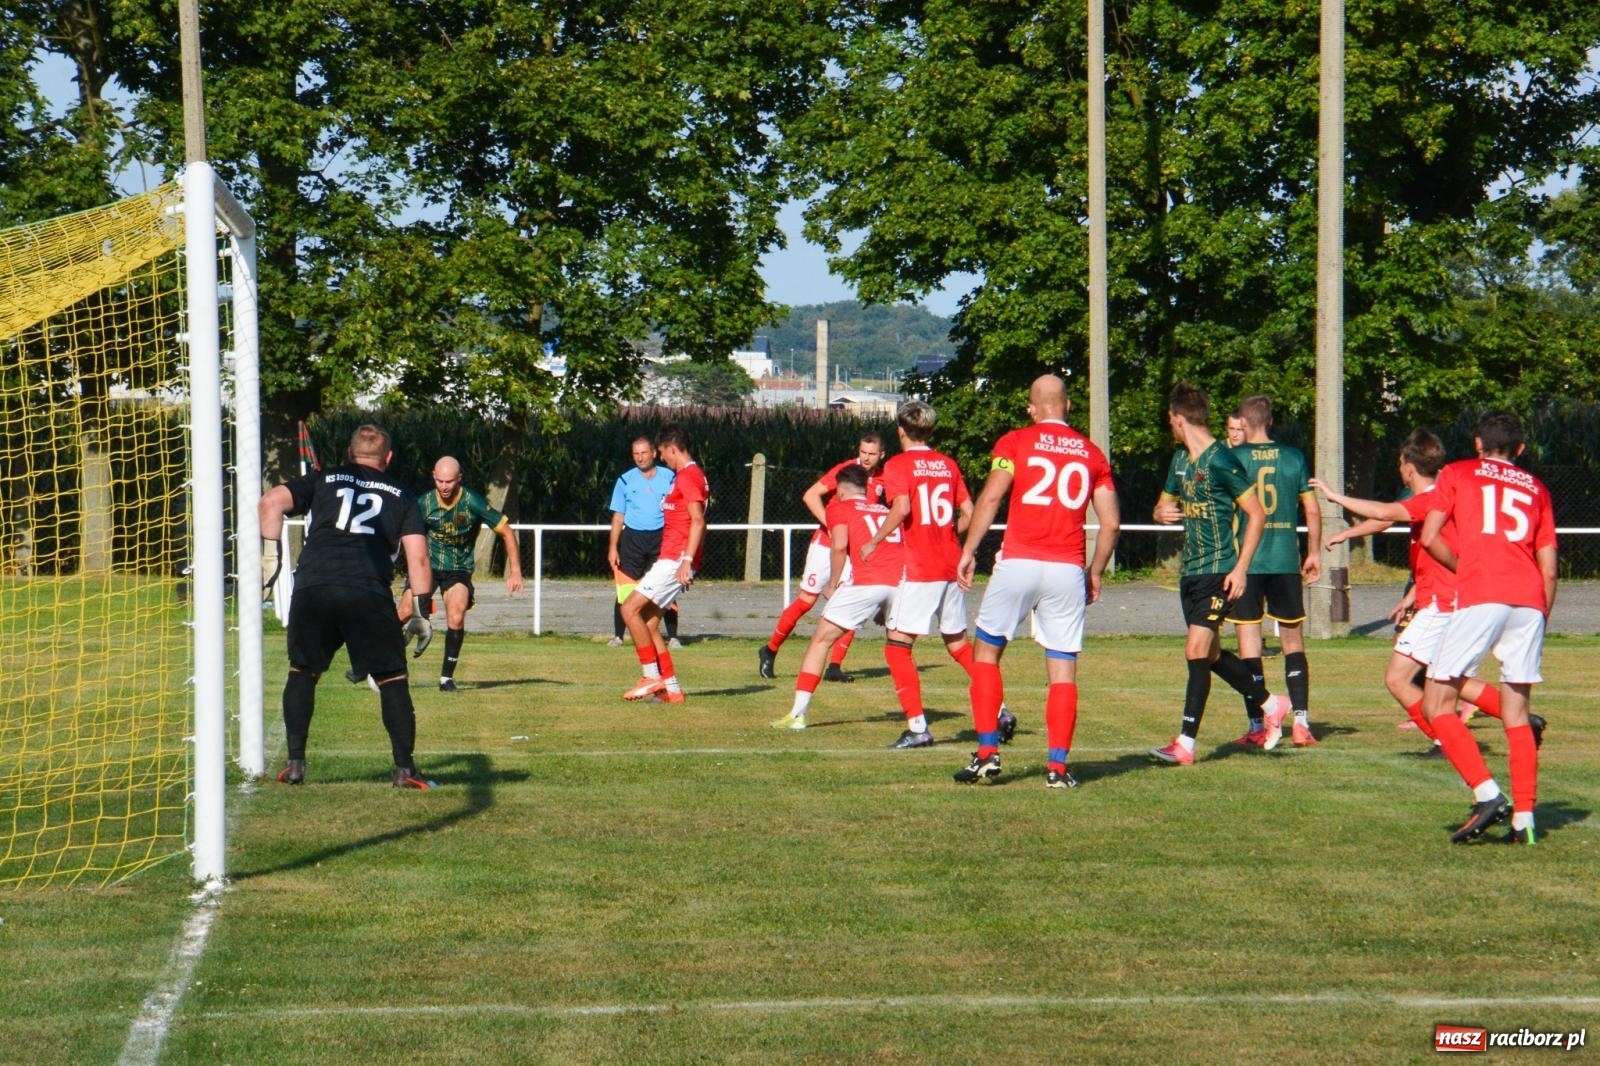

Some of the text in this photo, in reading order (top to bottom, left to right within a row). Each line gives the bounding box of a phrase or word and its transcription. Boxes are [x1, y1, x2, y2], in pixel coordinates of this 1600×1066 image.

[1034, 442, 1089, 459] KRZANOWICE
[1040, 434, 1084, 449] KS 1905
[914, 460, 946, 470] KS 1905
[998, 458, 1009, 469] C
[1252, 449, 1279, 460] START
[1021, 456, 1090, 510] 20
[1475, 469, 1539, 495] KRZANOWICE
[1481, 462, 1533, 484] KS 1905
[325, 473, 402, 497] KS 1905 KRZANOWICE
[1257, 466, 1278, 515] 6
[335, 487, 383, 535] 12
[917, 482, 954, 528] 16
[1480, 484, 1533, 543] 15
[807, 573, 816, 587] 6
[1210, 596, 1224, 610] 18
